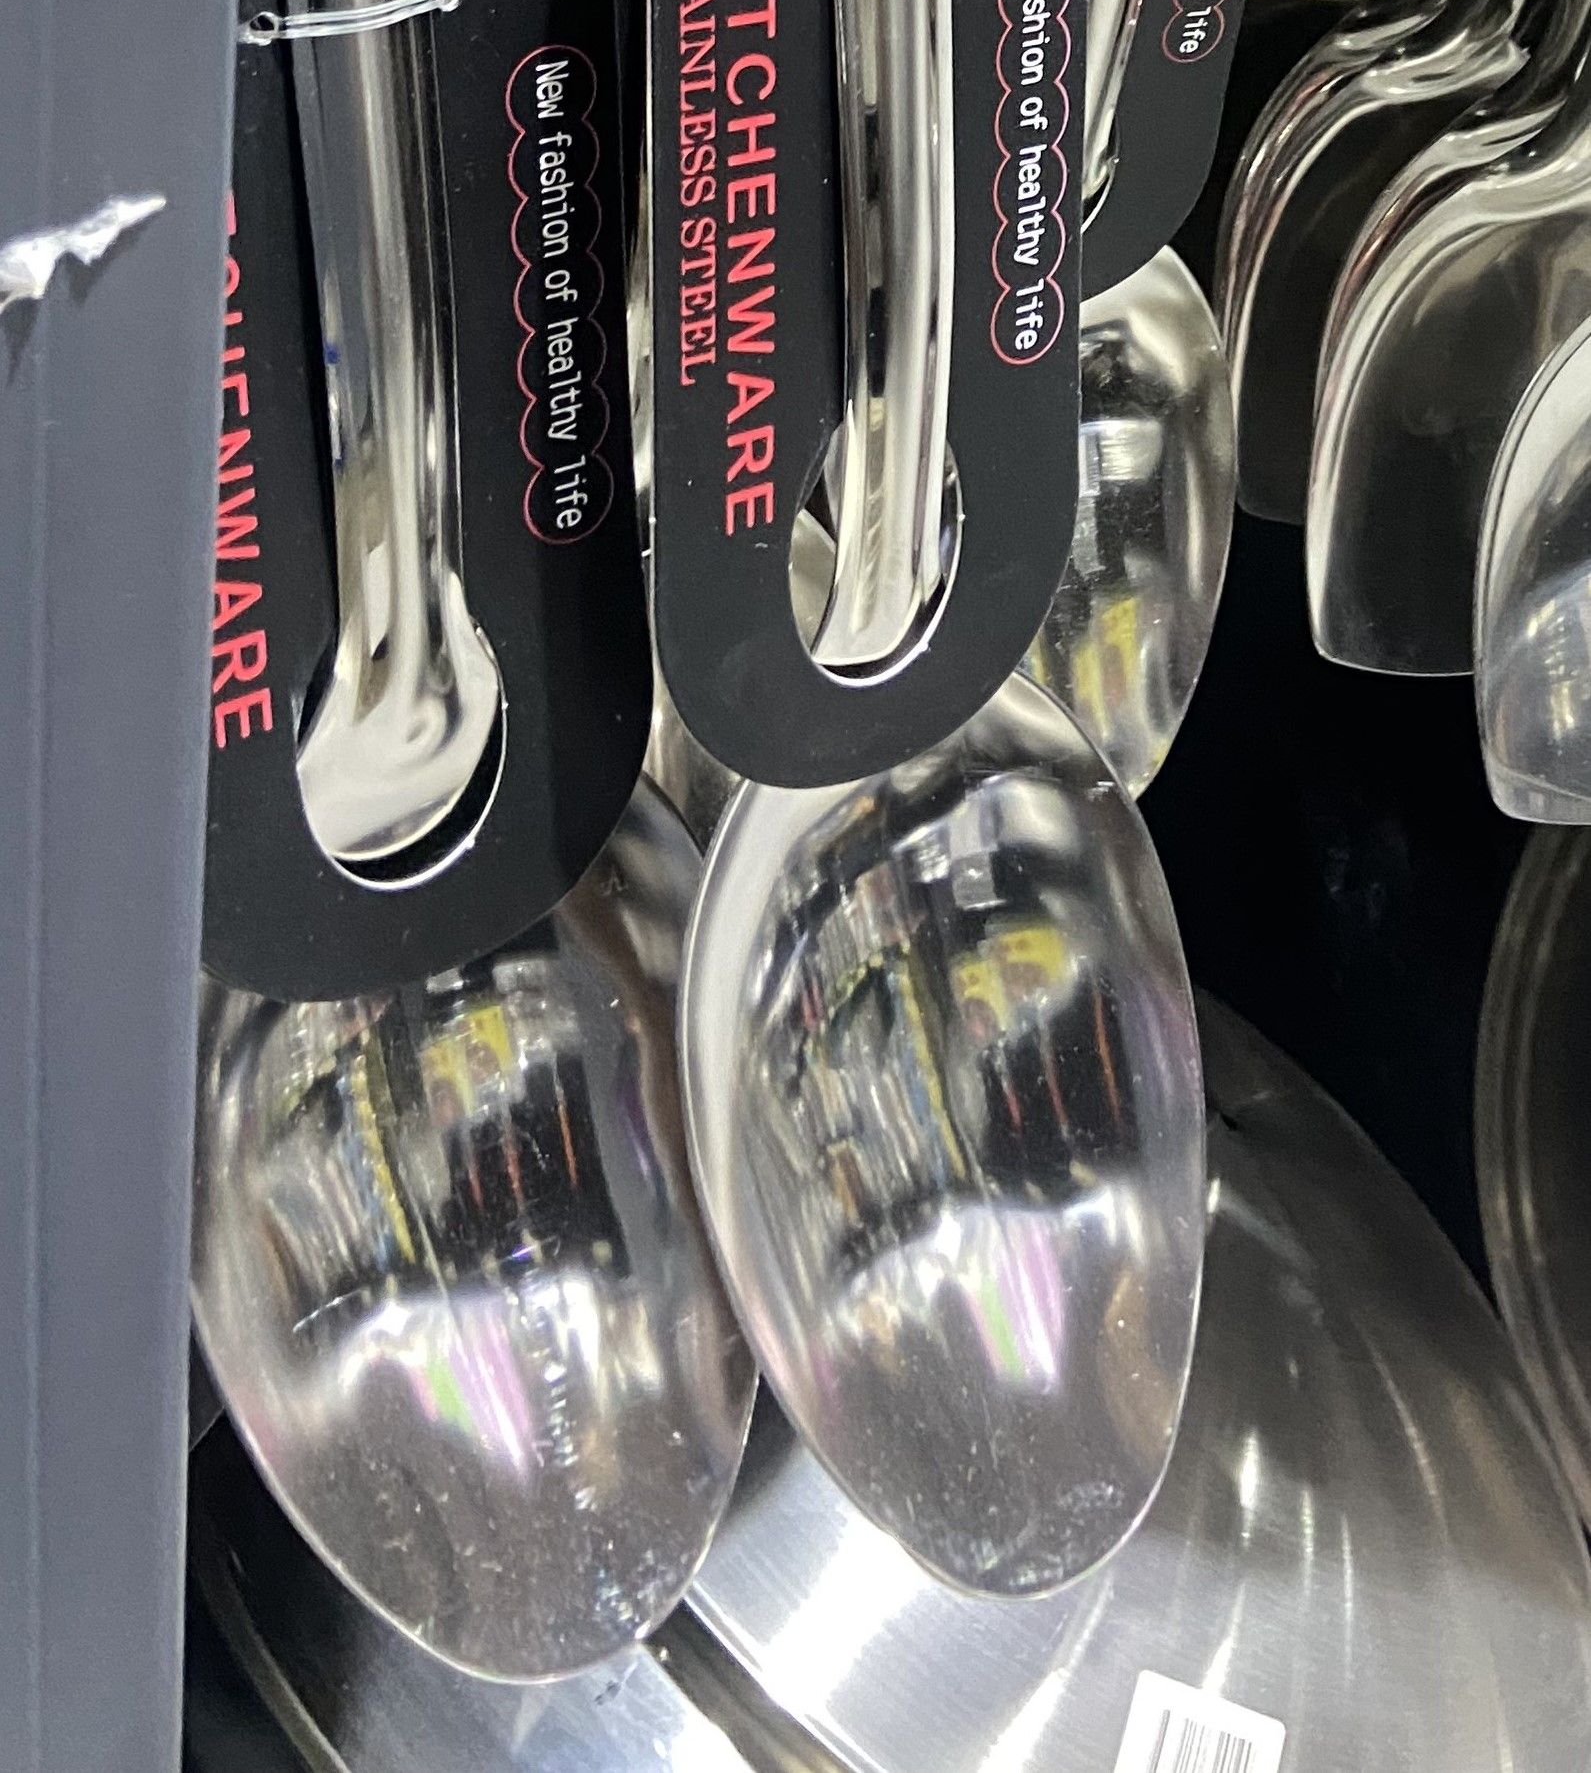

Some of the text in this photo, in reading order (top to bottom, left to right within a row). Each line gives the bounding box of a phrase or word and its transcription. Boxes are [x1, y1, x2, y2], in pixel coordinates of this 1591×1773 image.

[1179, 6, 1212, 54] life
[1021, 98, 1049, 130] of
[1015, 145, 1048, 266] healthy
[535, 59, 588, 529] New fashion of healthy life
[682, 218, 717, 386] STEEL
[1016, 279, 1045, 350] life
